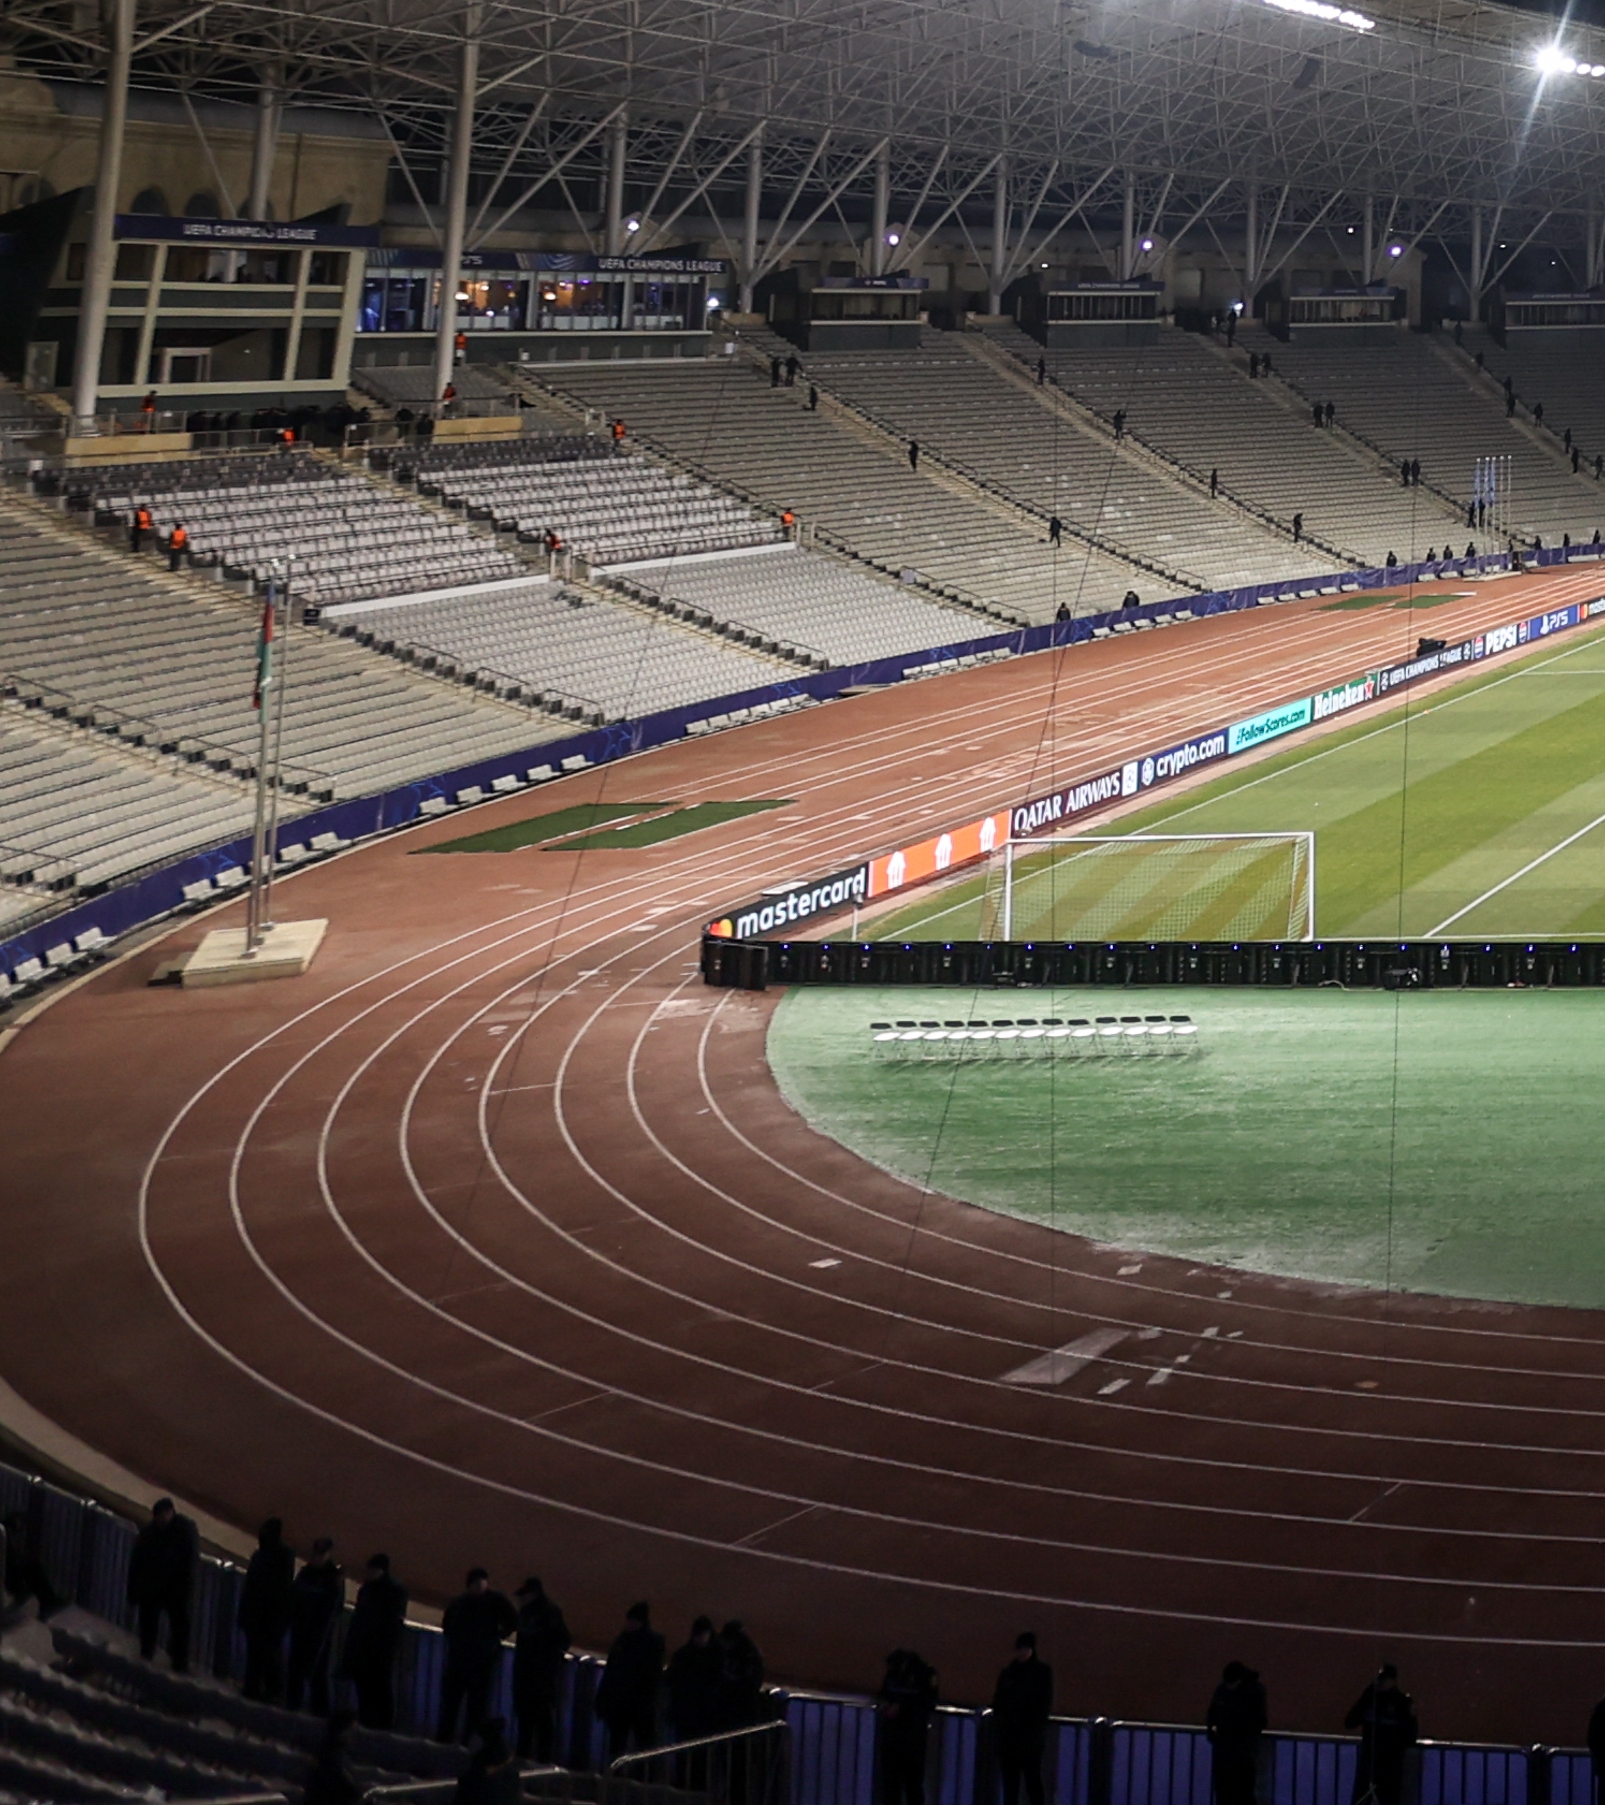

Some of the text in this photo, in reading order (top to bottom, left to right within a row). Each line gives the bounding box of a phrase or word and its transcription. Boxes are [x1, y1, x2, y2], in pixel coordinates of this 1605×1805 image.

[183, 223, 212, 236] UEFA
[277, 228, 317, 240] LEAGUE
[598, 258, 722, 272] UEFA CHAMPIONS LEAGUE
[1549, 610, 1568, 629] PS5
[1485, 625, 1517, 655] PEPSI
[1405, 654, 1438, 678] CHAMPIONS
[1313, 683, 1365, 720] Heineken
[1238, 708, 1305, 744] FollowScores.com
[1156, 735, 1225, 776] crypto.com
[1014, 772, 1120, 832] QATAR AIRWAYS
[735, 867, 866, 939] mastercard
